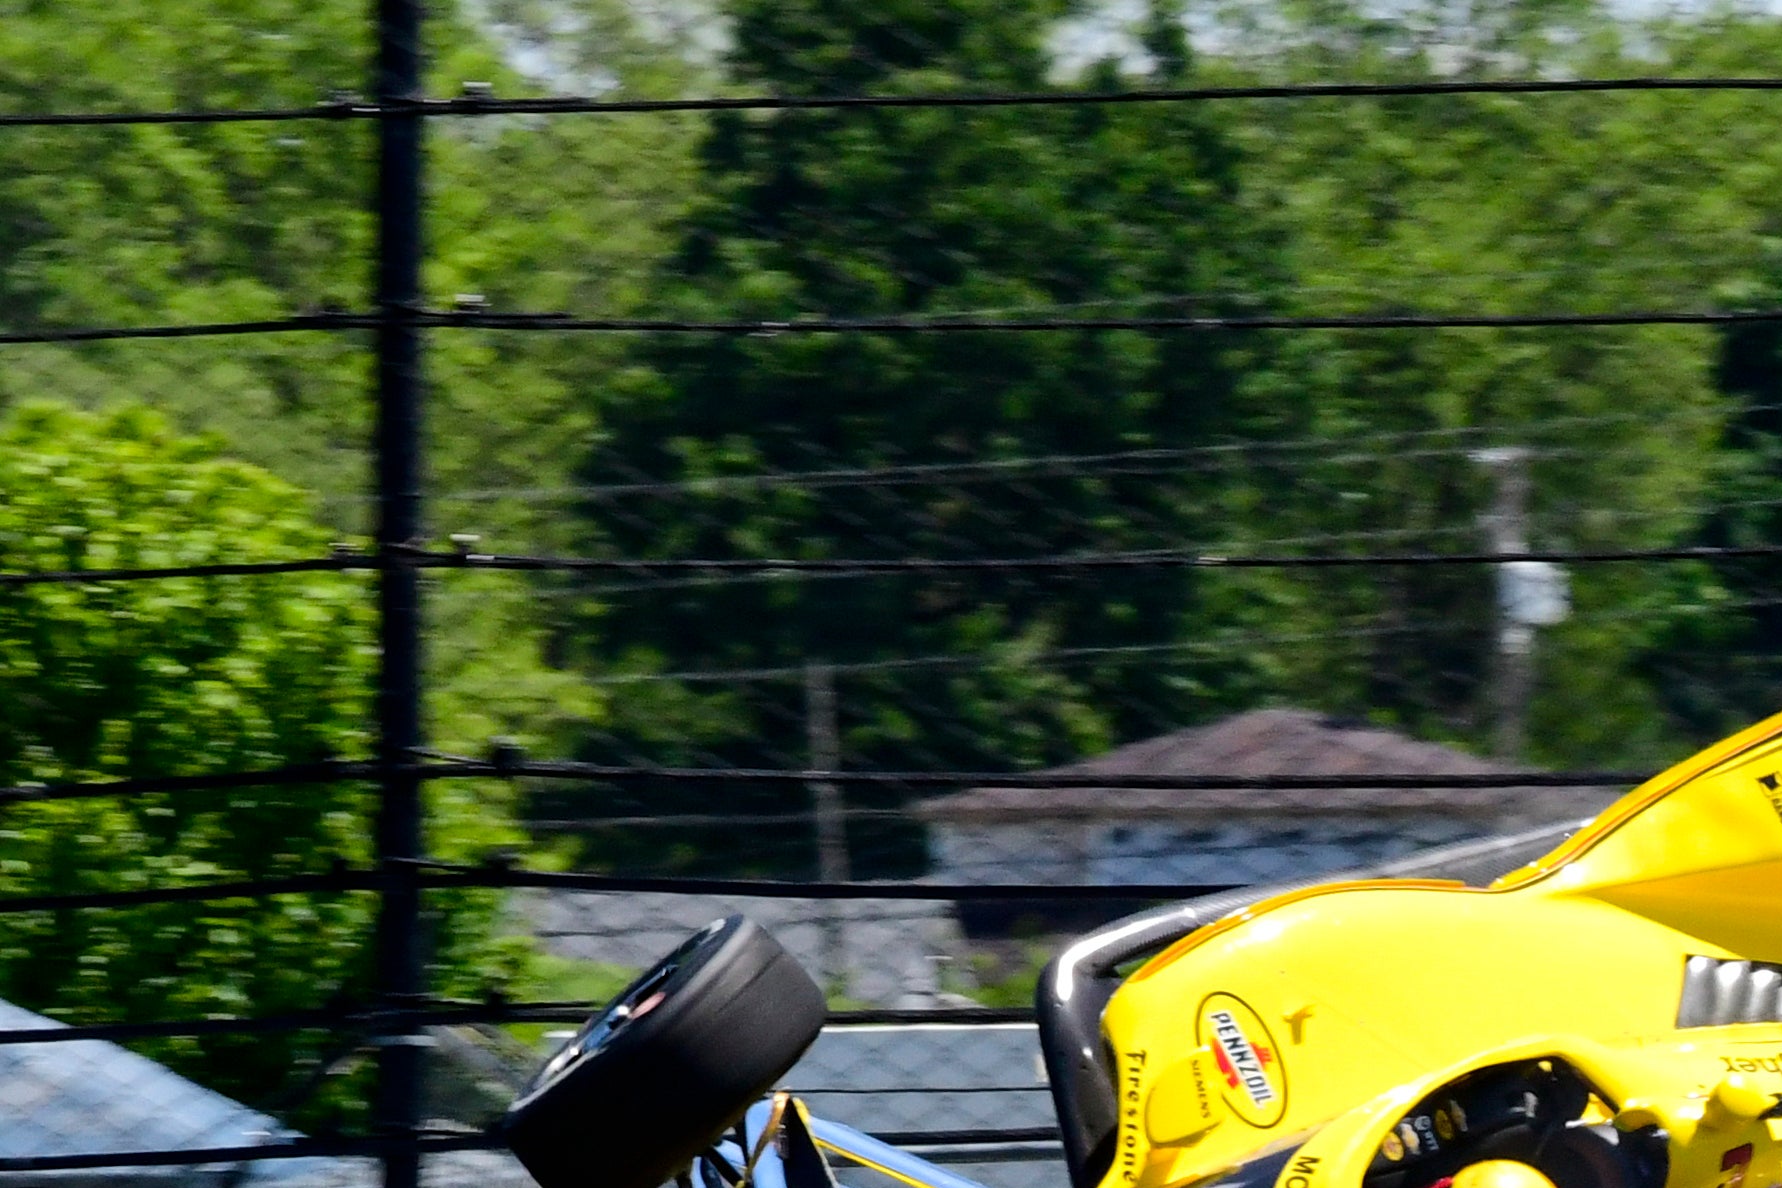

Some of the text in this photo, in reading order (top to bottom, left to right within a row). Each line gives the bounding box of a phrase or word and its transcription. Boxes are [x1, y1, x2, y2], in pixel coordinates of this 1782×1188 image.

[1190, 1058, 1212, 1120] SIEMENS
[1210, 1012, 1273, 1106] PENNZOIL
[1121, 1049, 1147, 1183] Firestone
